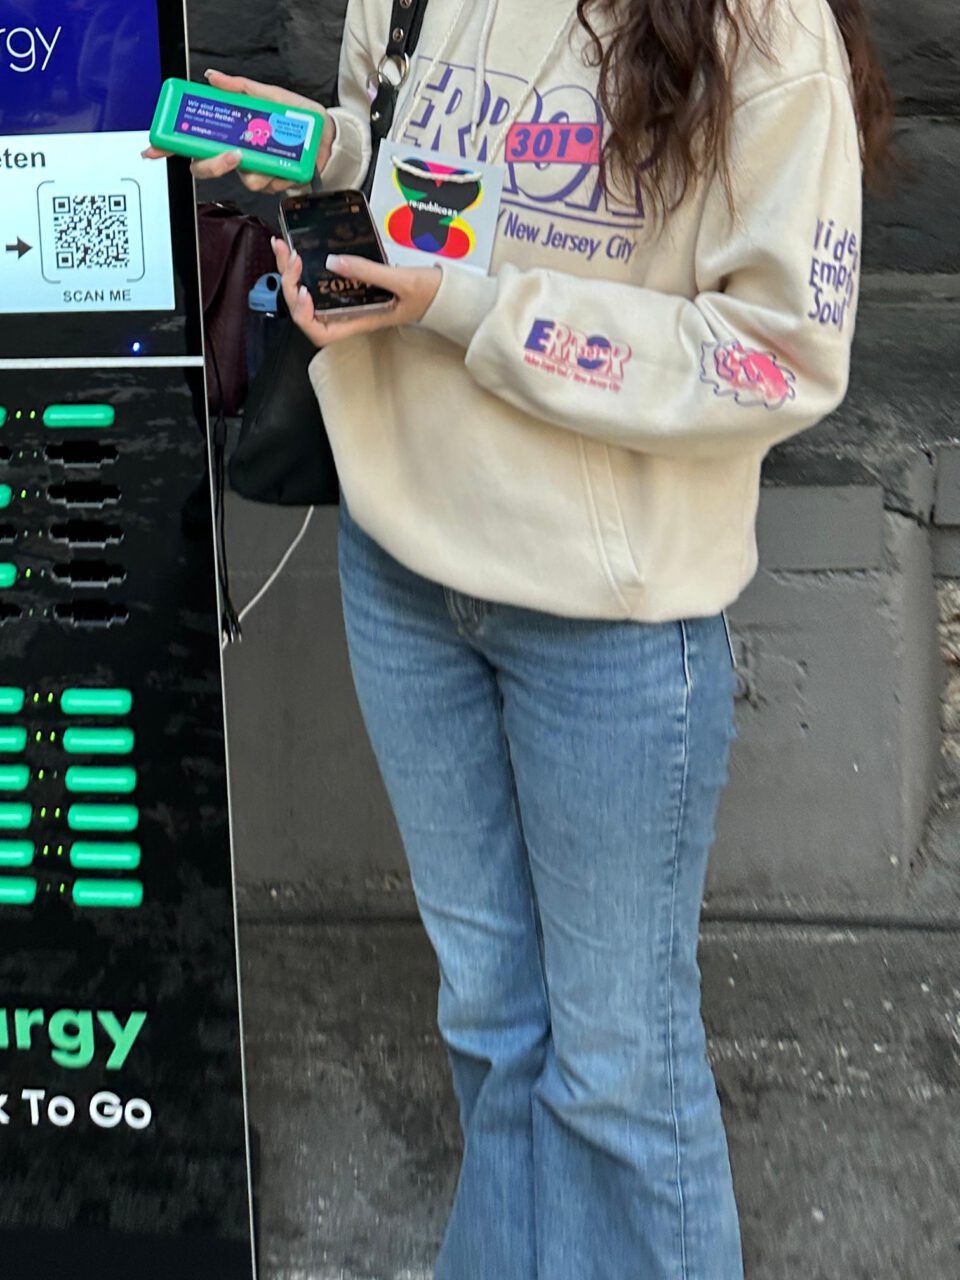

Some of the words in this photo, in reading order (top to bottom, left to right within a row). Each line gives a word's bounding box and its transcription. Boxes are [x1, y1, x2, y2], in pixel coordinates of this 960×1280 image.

[504, 211, 540, 243] New
[541, 222, 600, 262] Jersey
[605, 234, 637, 264] City
[62, 289, 105, 303] SCAN
[109, 288, 132, 302] ME
[21, 1089, 75, 1127] To
[89, 1091, 152, 1129] Go
